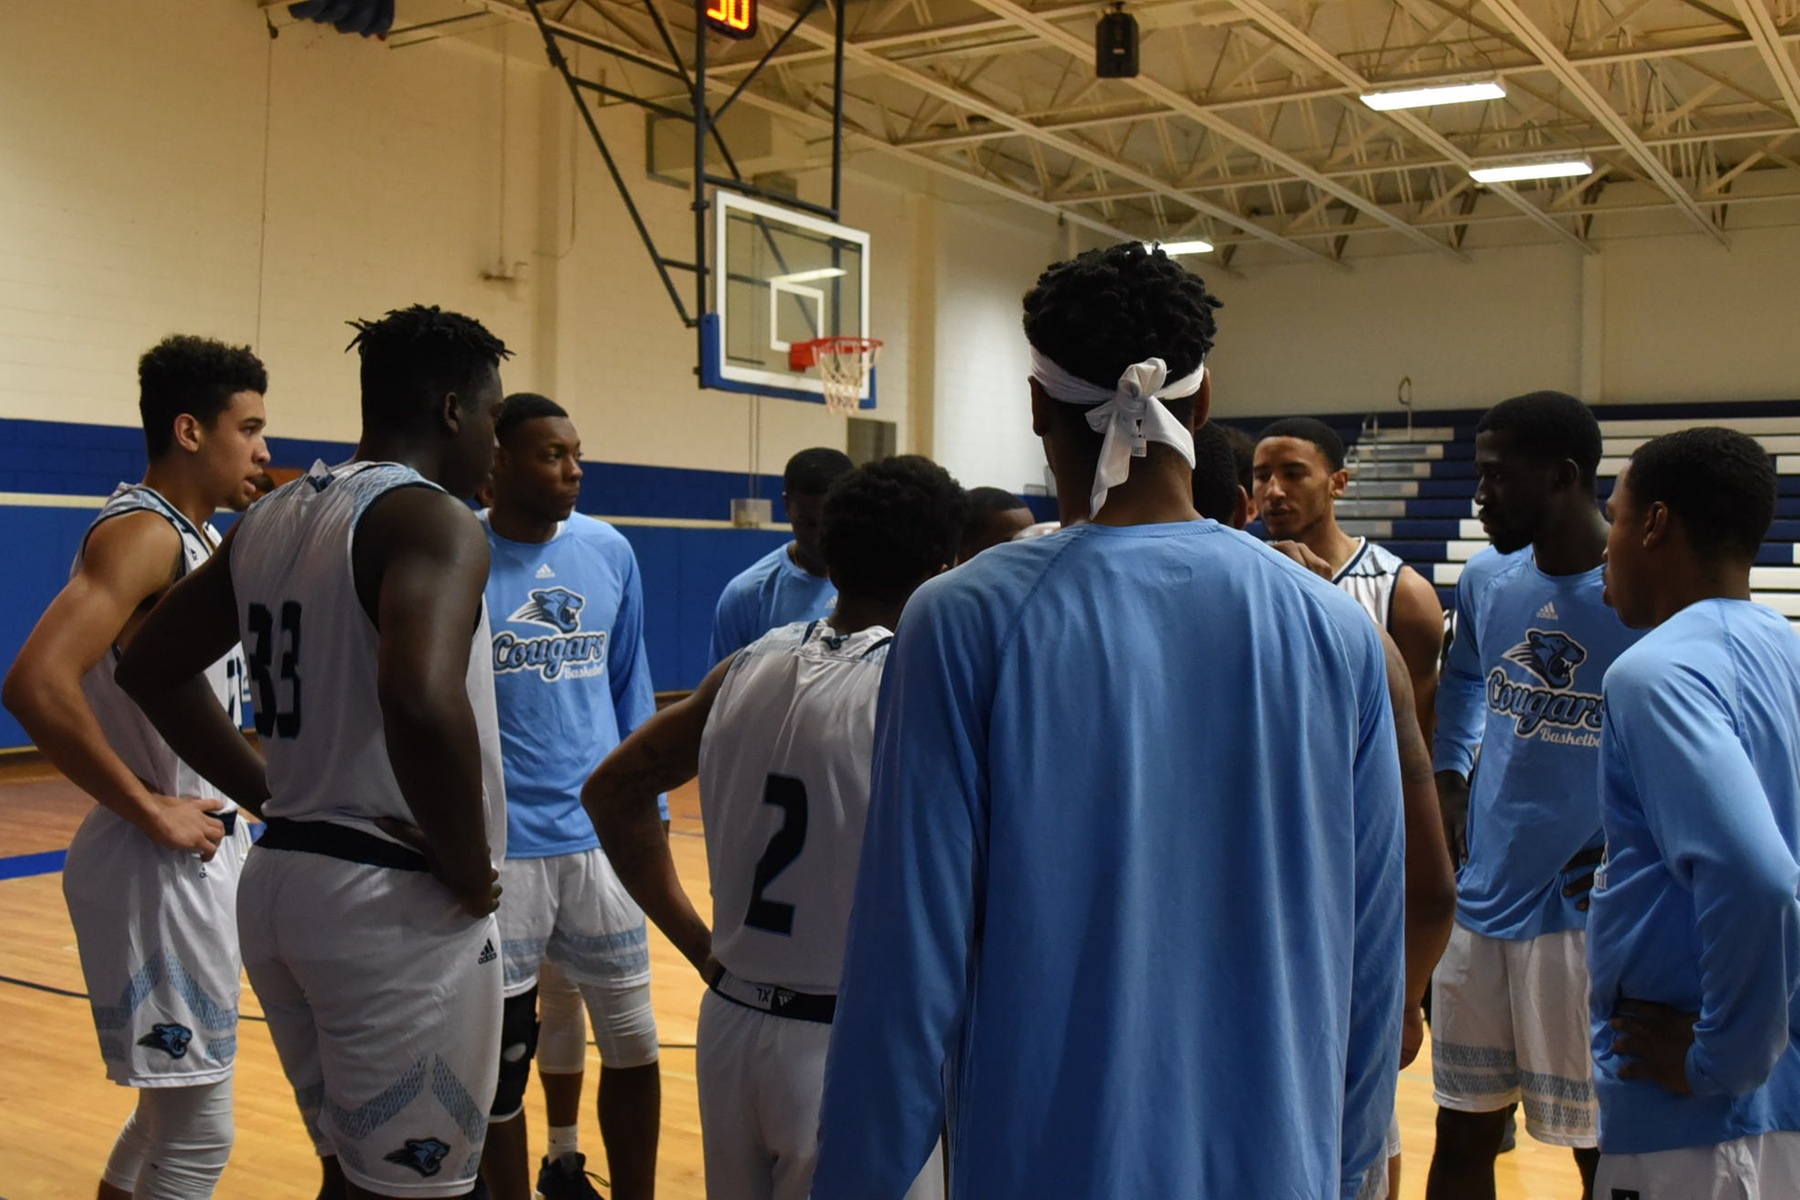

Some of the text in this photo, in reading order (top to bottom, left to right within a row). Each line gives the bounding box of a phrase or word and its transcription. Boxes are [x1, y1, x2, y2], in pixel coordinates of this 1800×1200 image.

[248, 601, 302, 740] 33
[493, 631, 606, 682] Cougars
[1487, 666, 1604, 738] Cougars
[744, 773, 808, 937] 2
